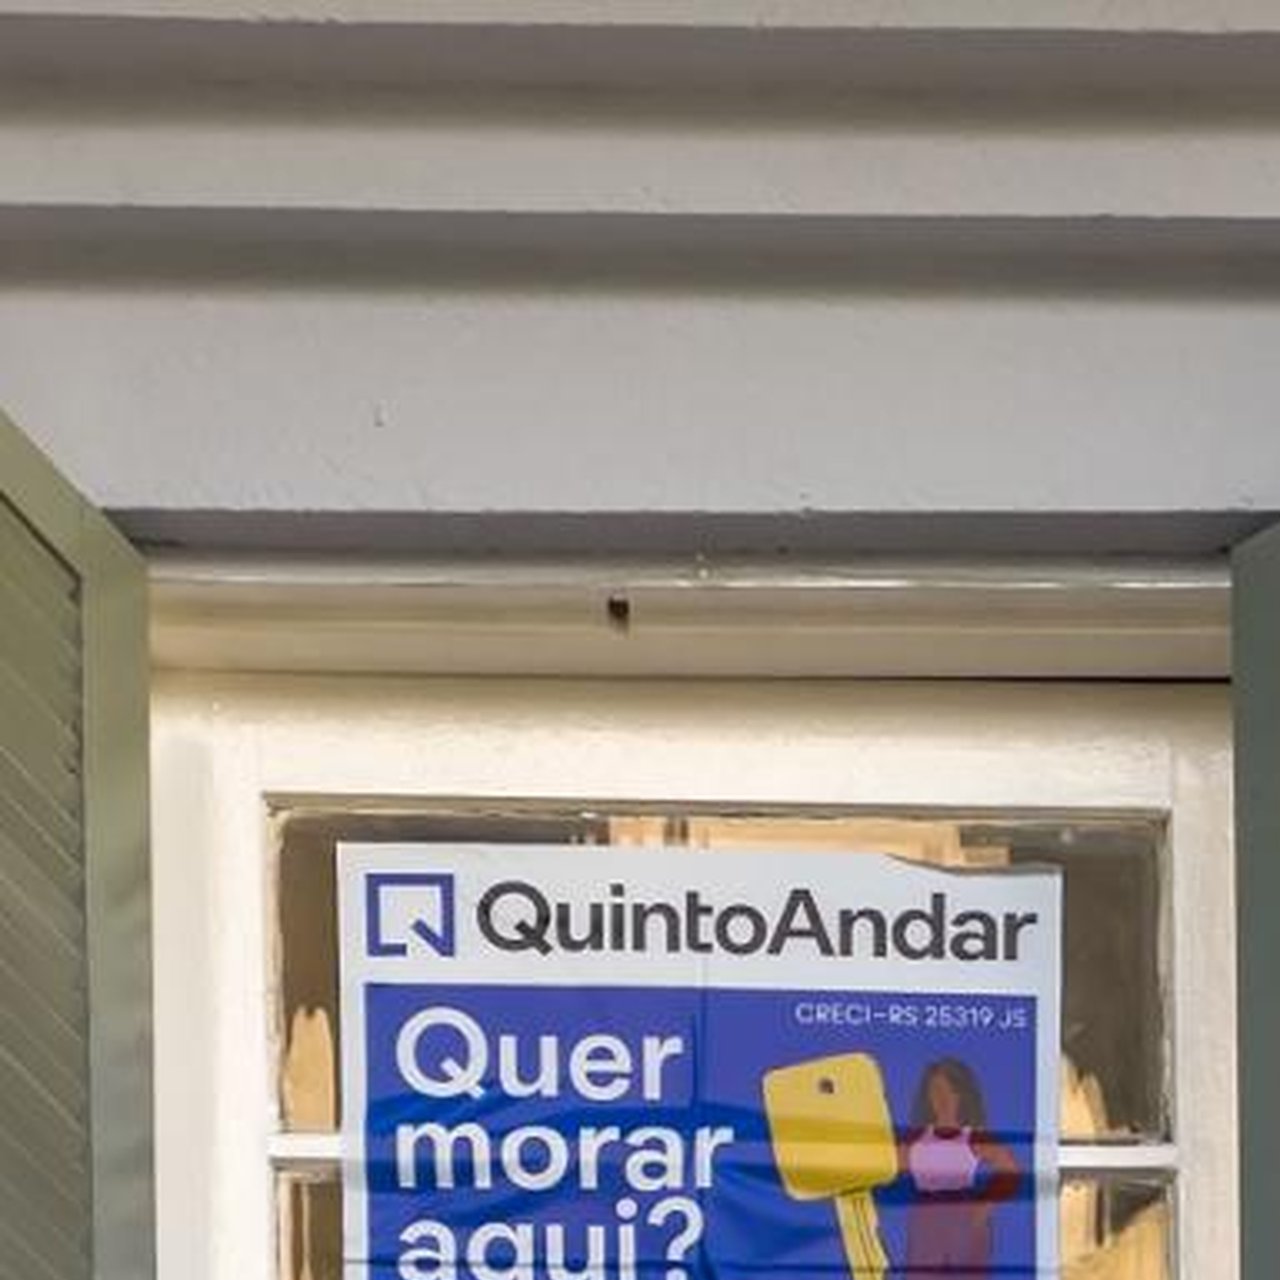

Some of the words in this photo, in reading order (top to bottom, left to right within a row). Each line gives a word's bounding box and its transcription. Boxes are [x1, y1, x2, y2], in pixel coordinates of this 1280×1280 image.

[477, 881, 1037, 961] QuintoAndar
[396, 1006, 684, 1101] Quer
[999, 1009, 1027, 1028] JS
[397, 1122, 734, 1191] morar
